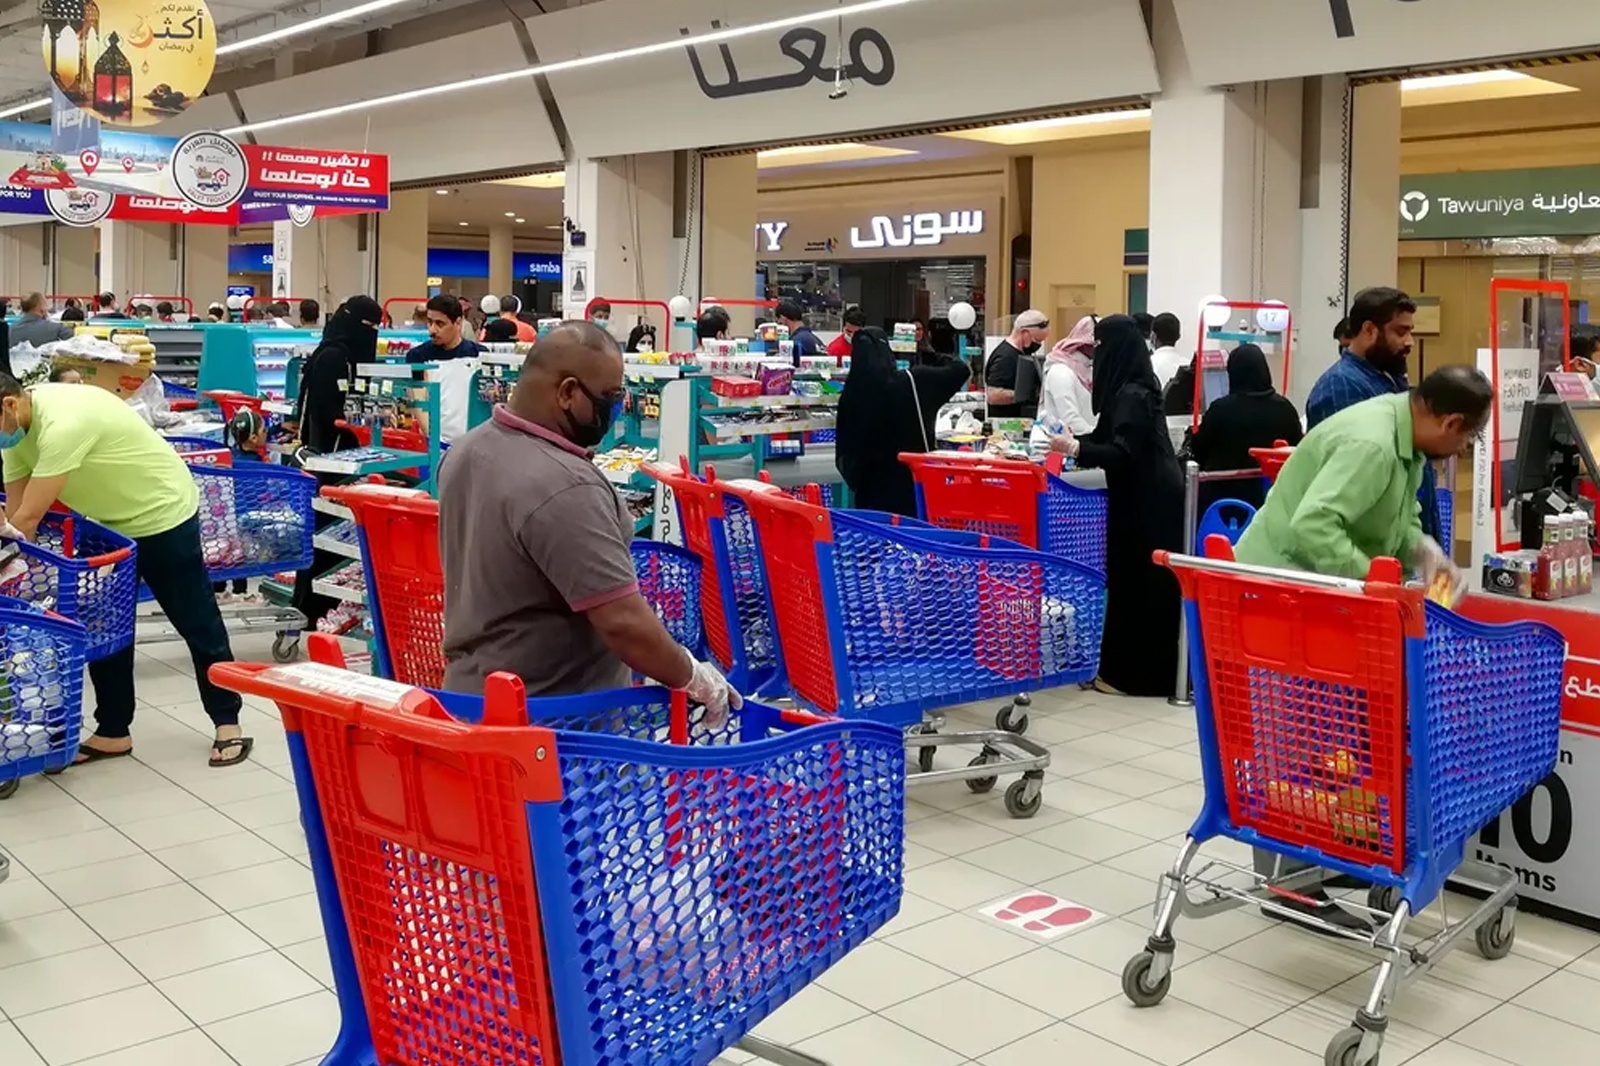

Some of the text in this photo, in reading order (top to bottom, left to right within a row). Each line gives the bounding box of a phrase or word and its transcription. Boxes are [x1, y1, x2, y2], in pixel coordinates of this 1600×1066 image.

[158, 42, 186, 53] رمضان
[359, 158, 370, 168] لا
[15, 191, 32, 199] YOU
[1438, 196, 1525, 216] Tawuniya
[1531, 191, 1600, 214] عاونية
[529, 261, 561, 274] samba
[1263, 311, 1278, 322] 17
